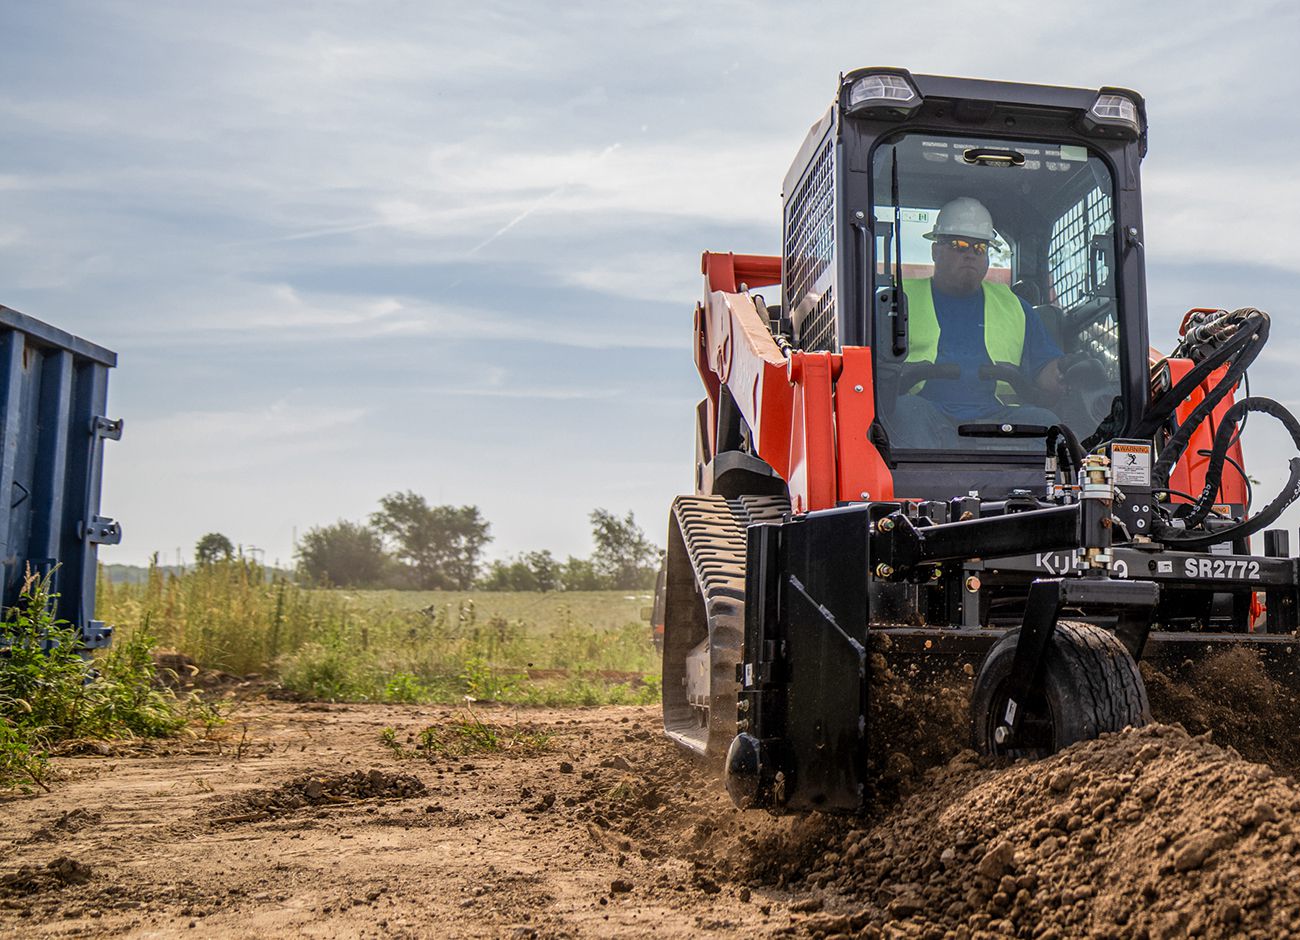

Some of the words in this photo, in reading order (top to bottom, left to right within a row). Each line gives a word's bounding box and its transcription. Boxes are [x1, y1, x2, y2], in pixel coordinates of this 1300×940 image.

[1120, 445, 1149, 453] WARNING
[1036, 550, 1128, 578] Kua
[1185, 558, 1260, 579] SR2772
